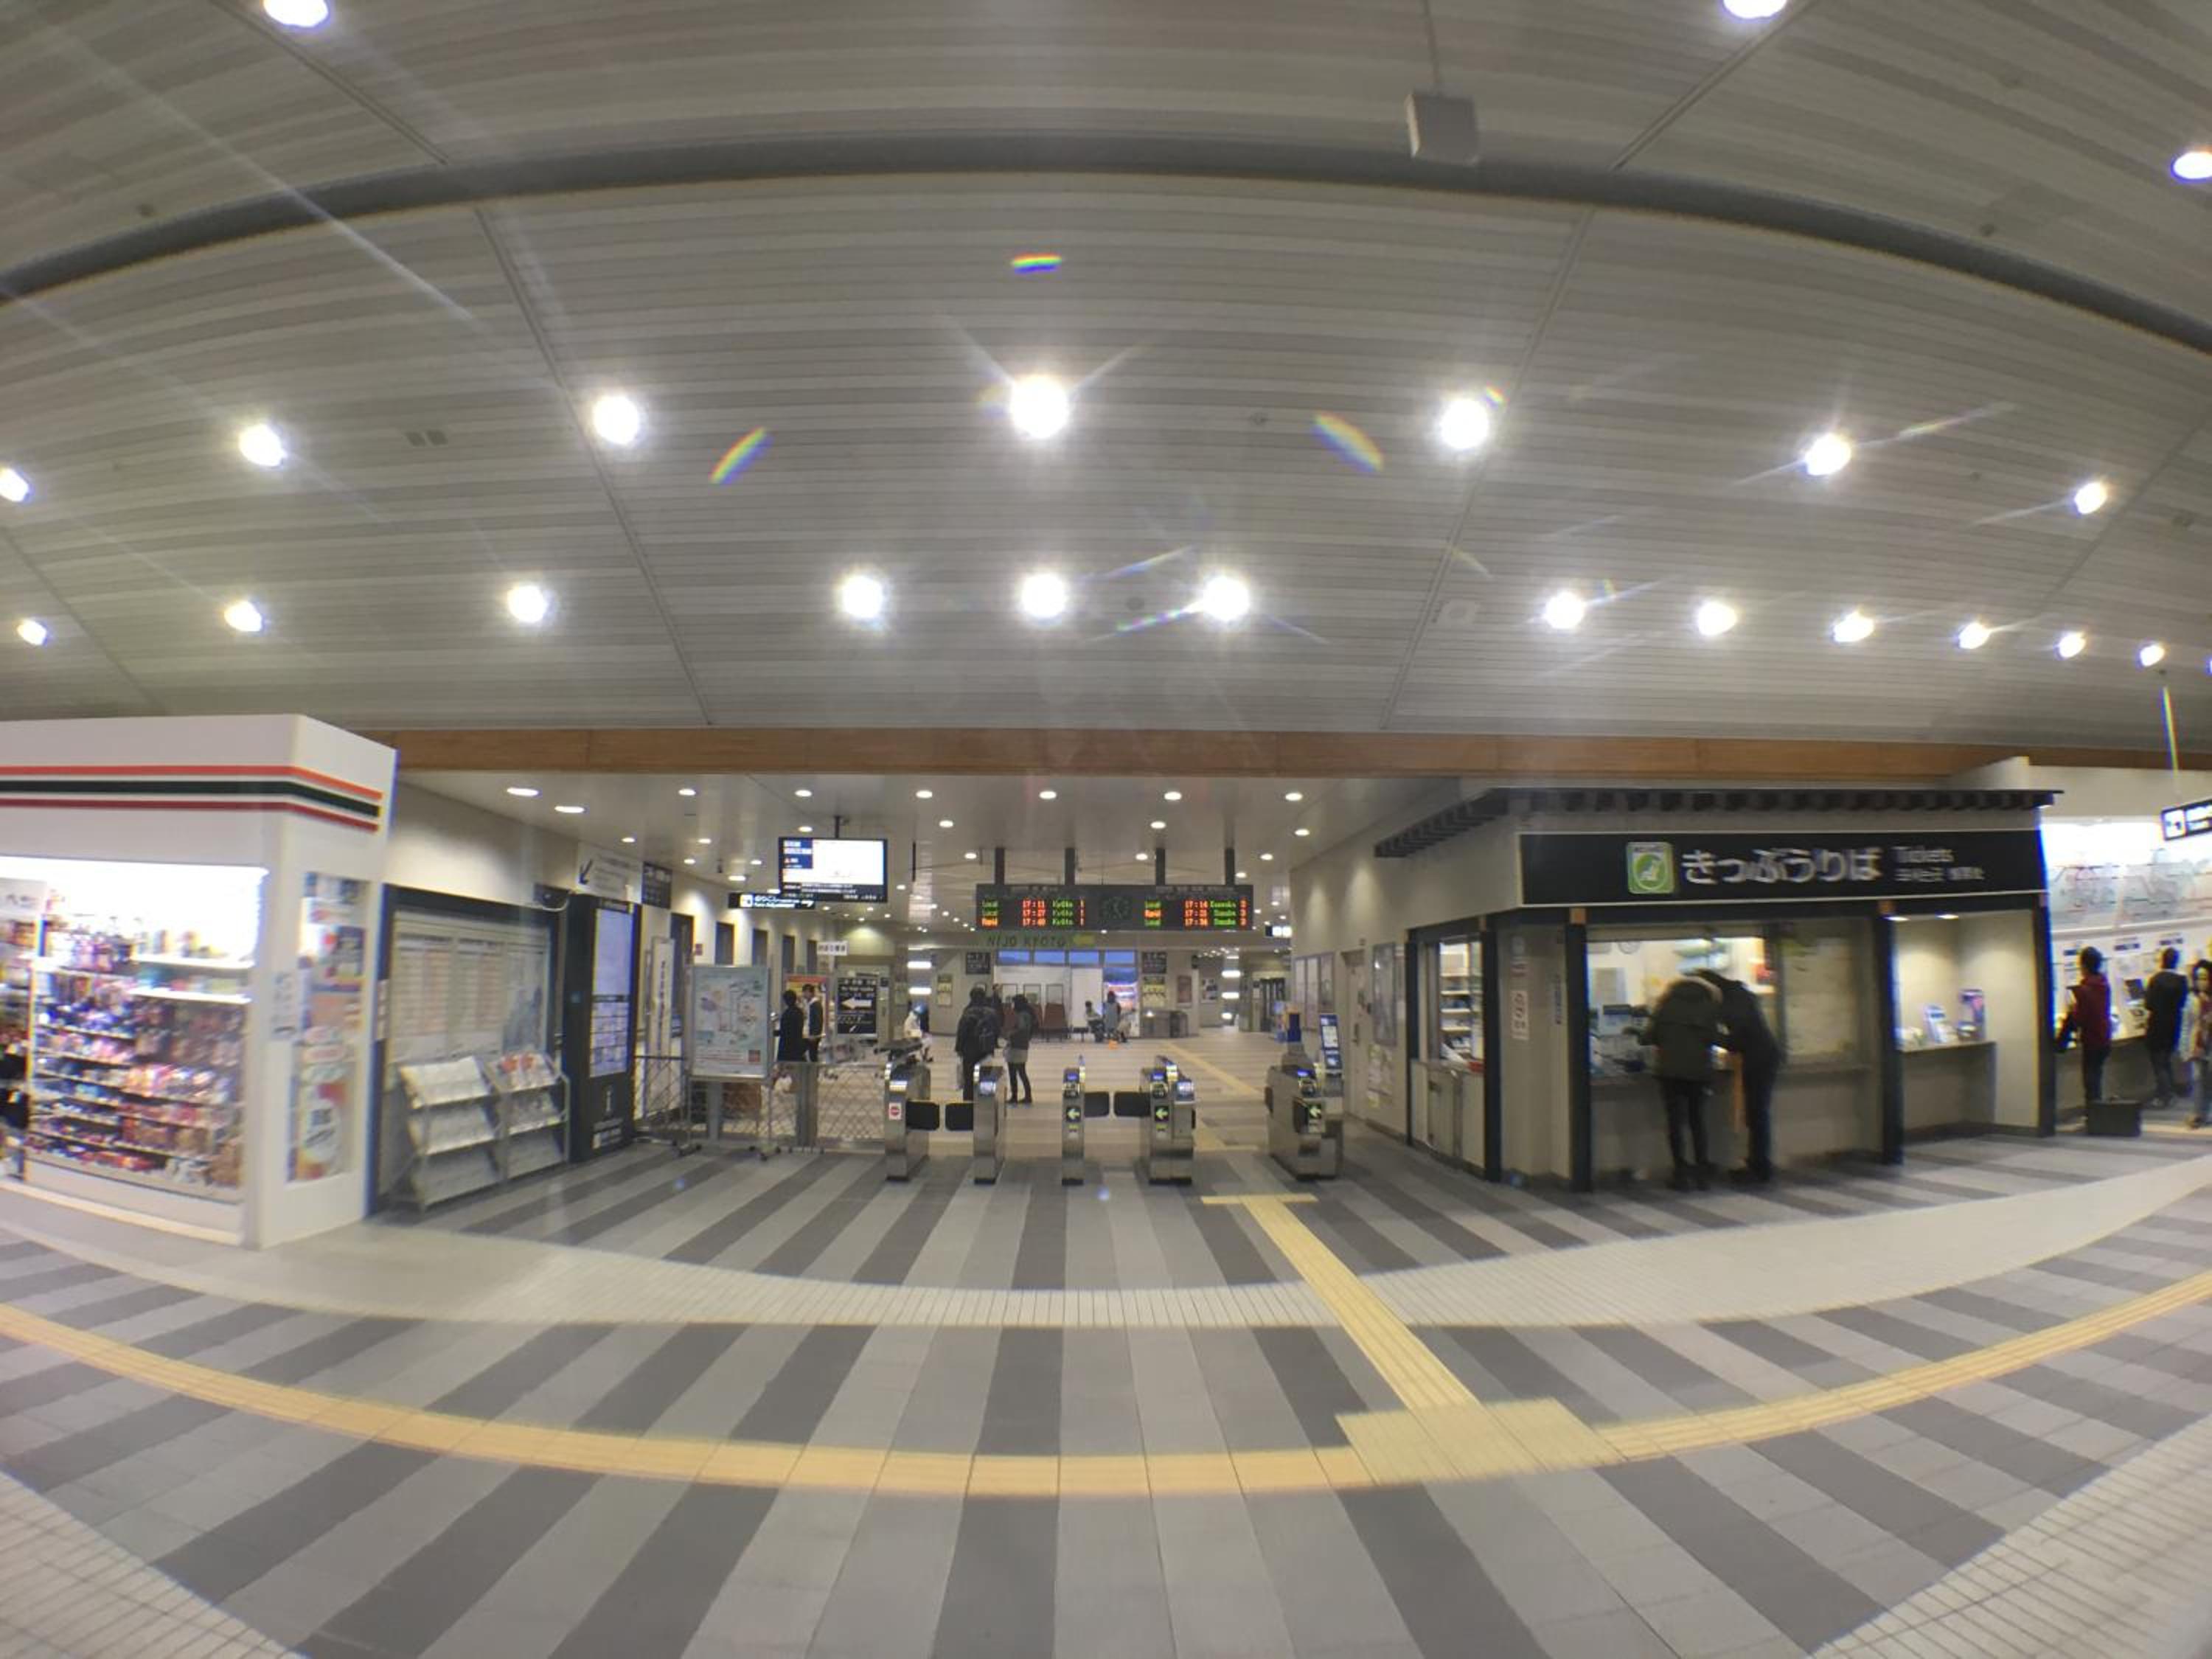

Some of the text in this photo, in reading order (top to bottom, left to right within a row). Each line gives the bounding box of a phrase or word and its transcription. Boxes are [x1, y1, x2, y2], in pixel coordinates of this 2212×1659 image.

[1682, 848, 1883, 883] きっぷうりば
[1891, 846, 1955, 863] Tickets
